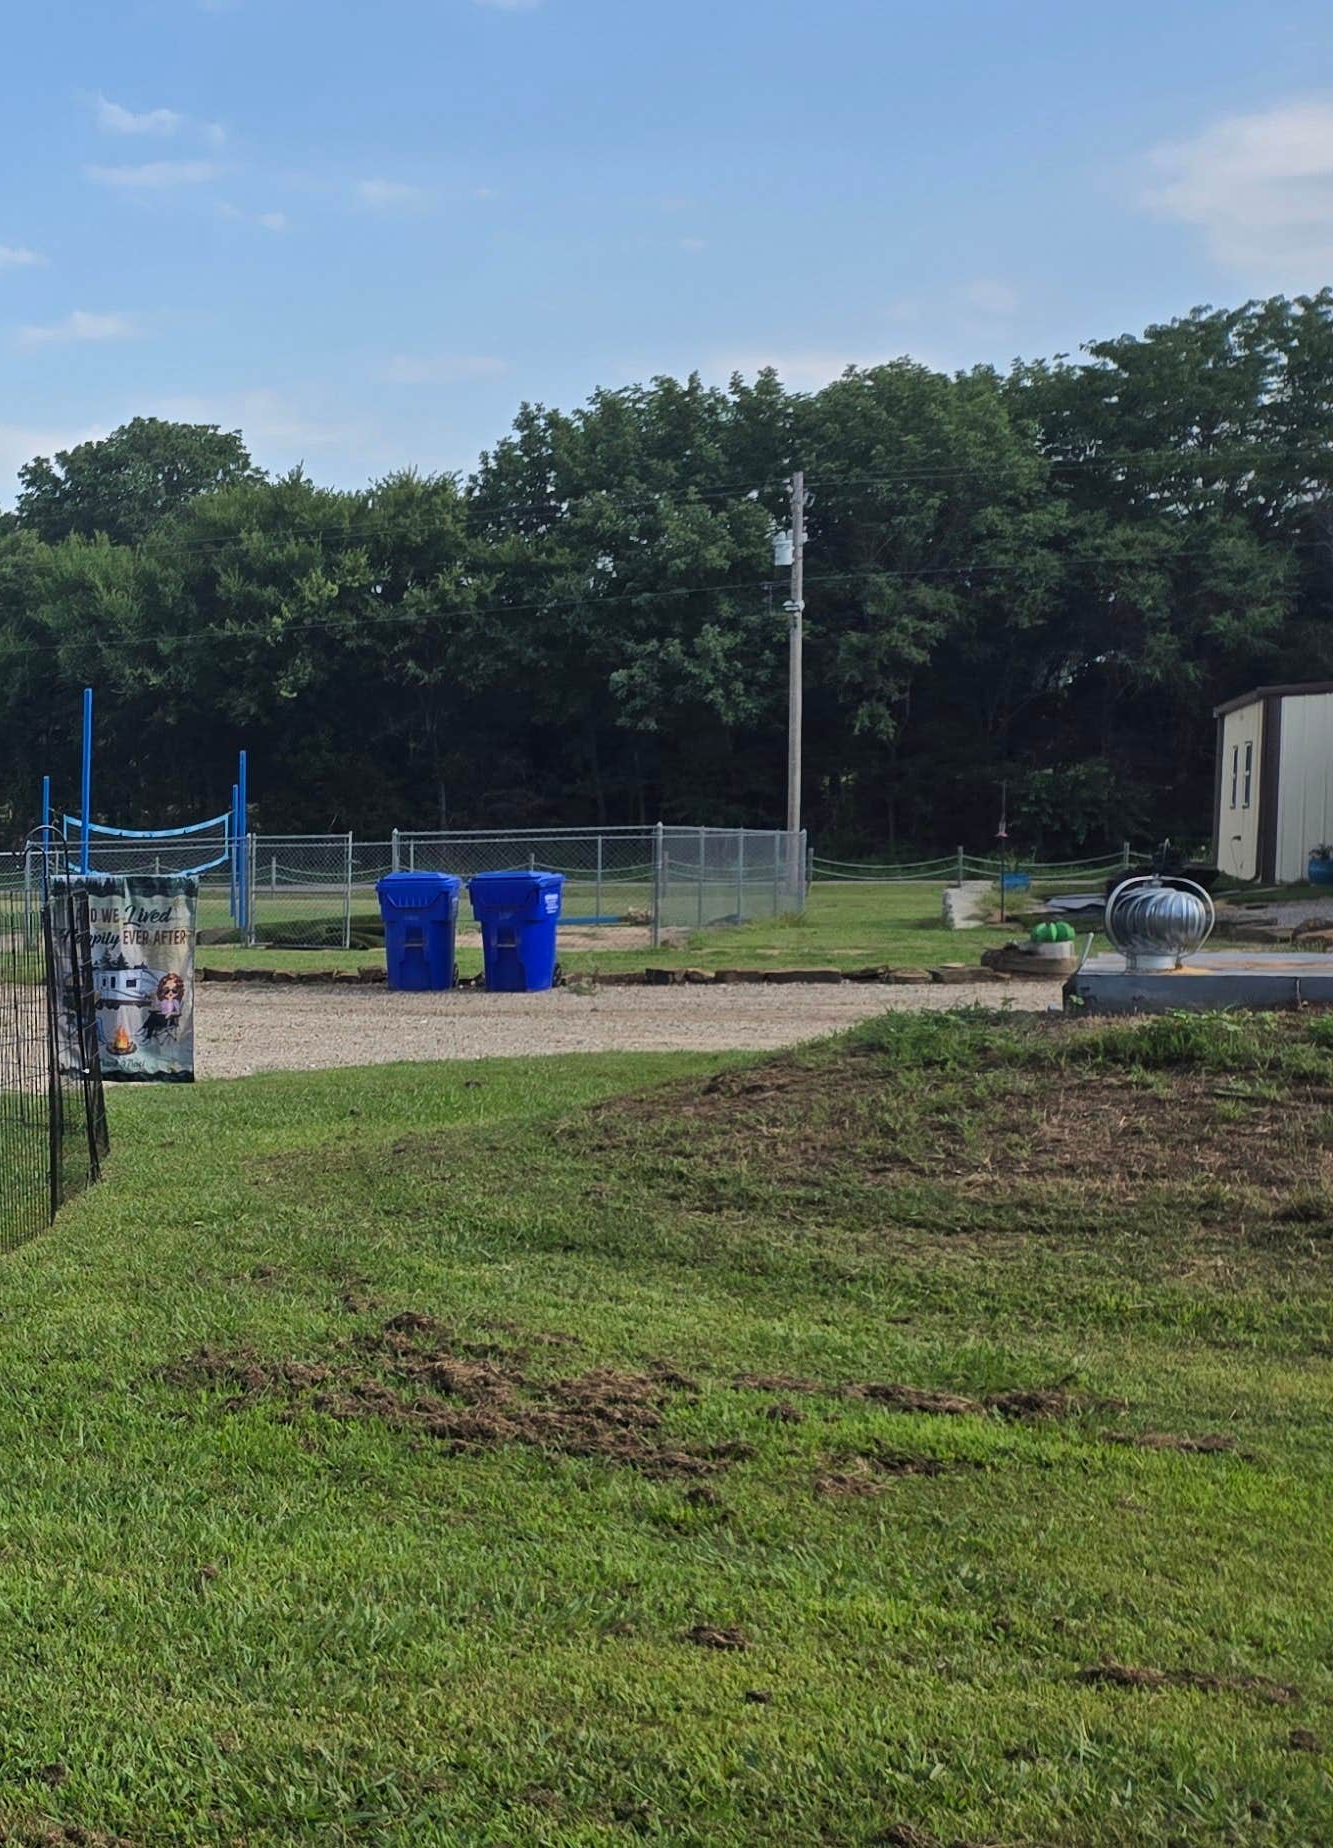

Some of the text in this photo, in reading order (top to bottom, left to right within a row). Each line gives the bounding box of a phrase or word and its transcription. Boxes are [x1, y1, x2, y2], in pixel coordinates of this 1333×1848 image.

[101, 908, 120, 923] WE
[123, 905, 172, 927] Lived
[123, 930, 151, 945] EVER
[153, 929, 186, 945] AFTER
